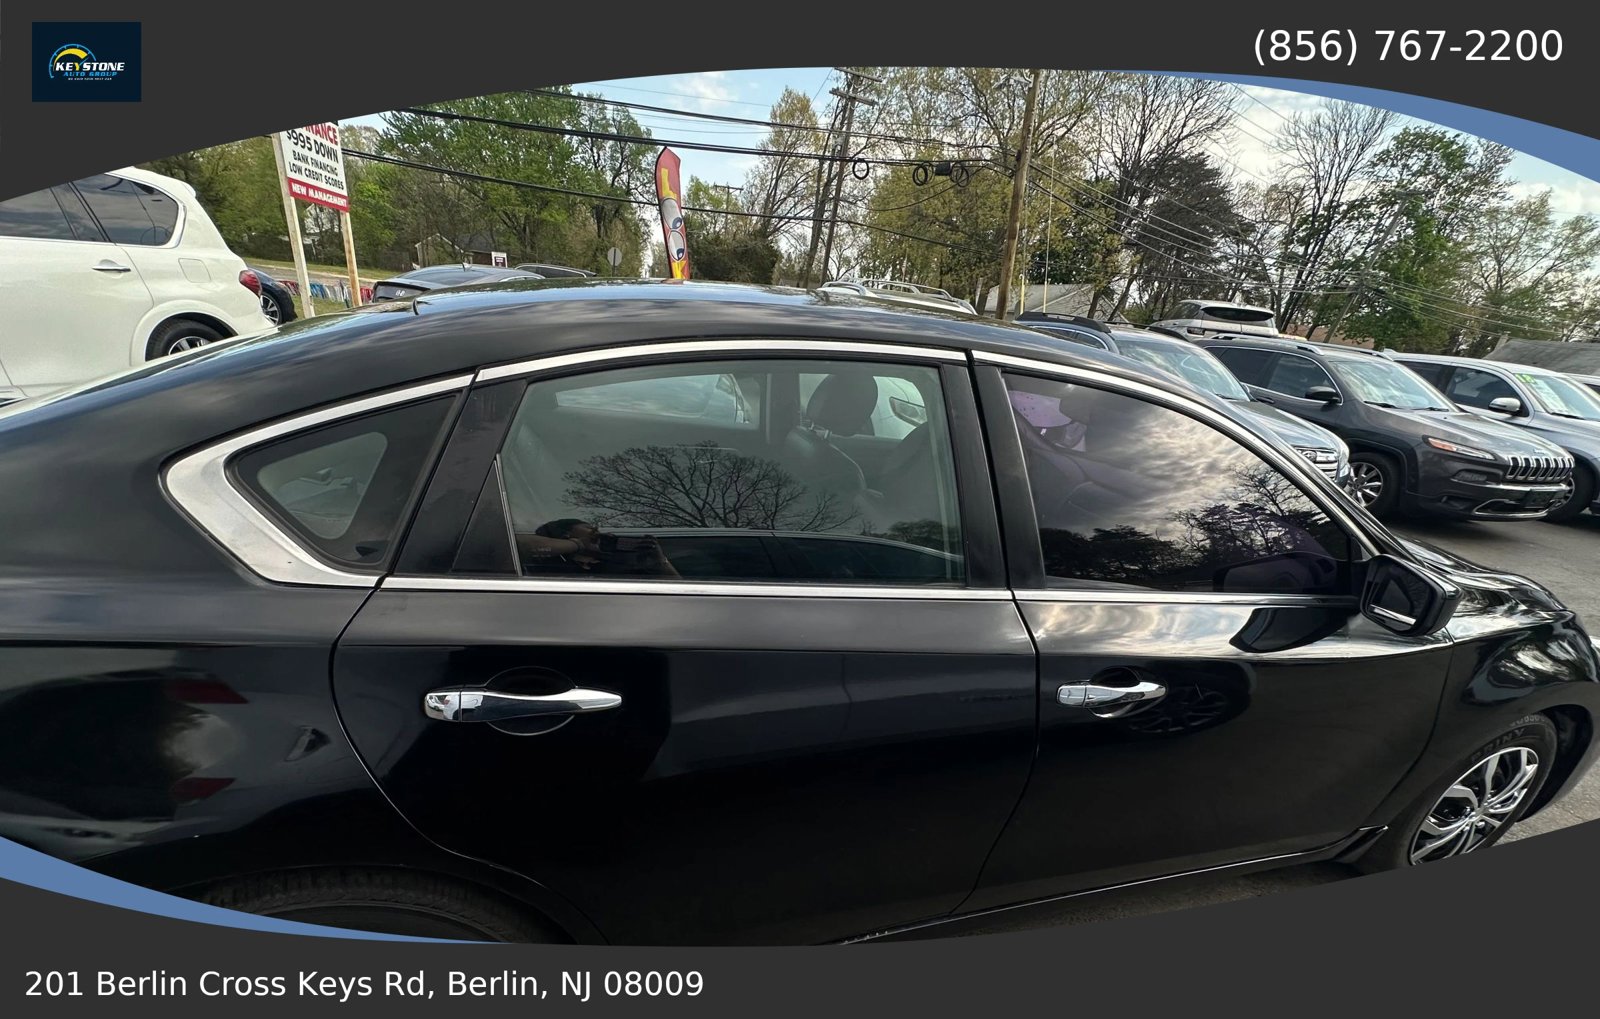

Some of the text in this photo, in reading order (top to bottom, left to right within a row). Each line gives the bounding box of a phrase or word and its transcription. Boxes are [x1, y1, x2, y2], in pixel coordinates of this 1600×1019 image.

[292, 150, 338, 176] BANK FINANCING
[313, 139, 339, 163] DOWN
[289, 162, 344, 190] LOW CREDIT SCORES
[291, 182, 347, 208] NEW MANAGEMENT
